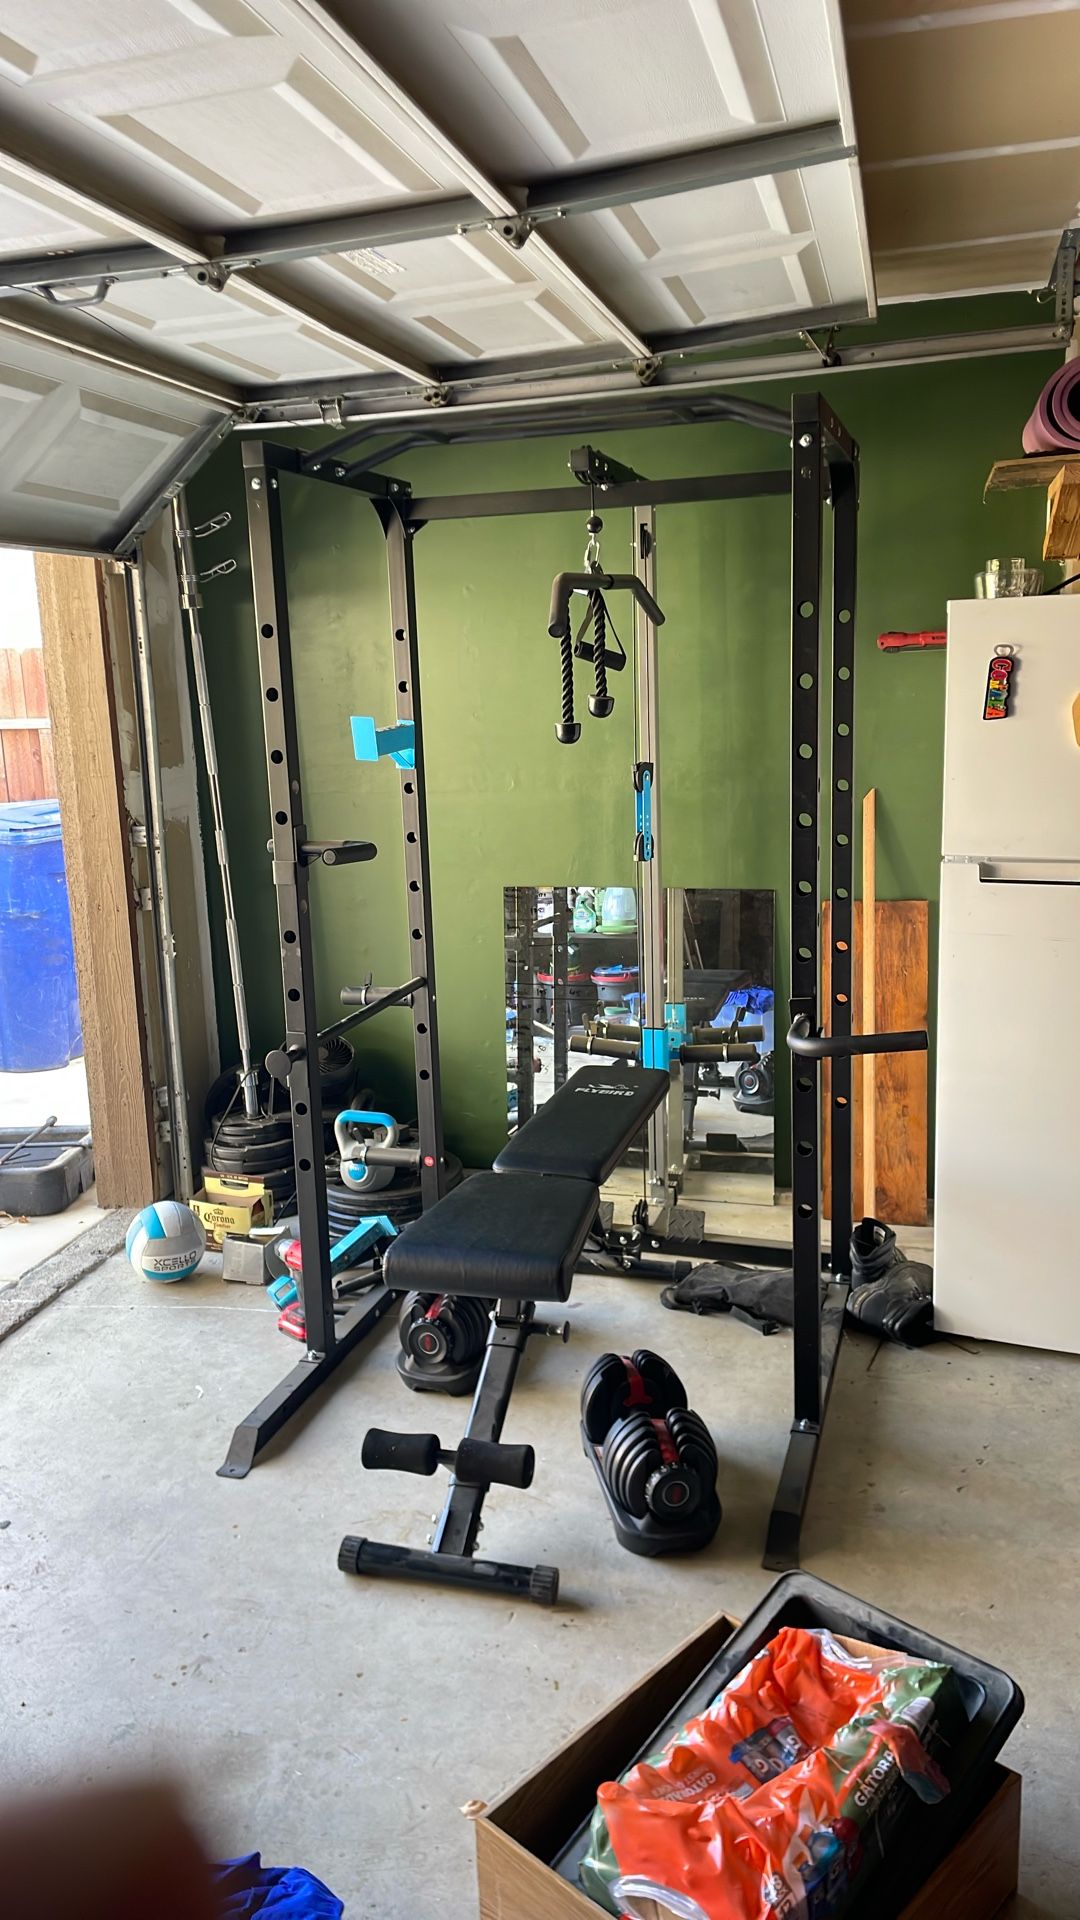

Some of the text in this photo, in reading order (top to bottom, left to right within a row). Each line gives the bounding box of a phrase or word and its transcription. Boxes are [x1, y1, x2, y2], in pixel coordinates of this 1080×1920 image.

[574, 1087, 635, 1097] FLYBIRD
[203, 1211, 236, 1225] Corona
[153, 1250, 197, 1267] XCELLO
[853, 1749, 896, 1807] GATORA
